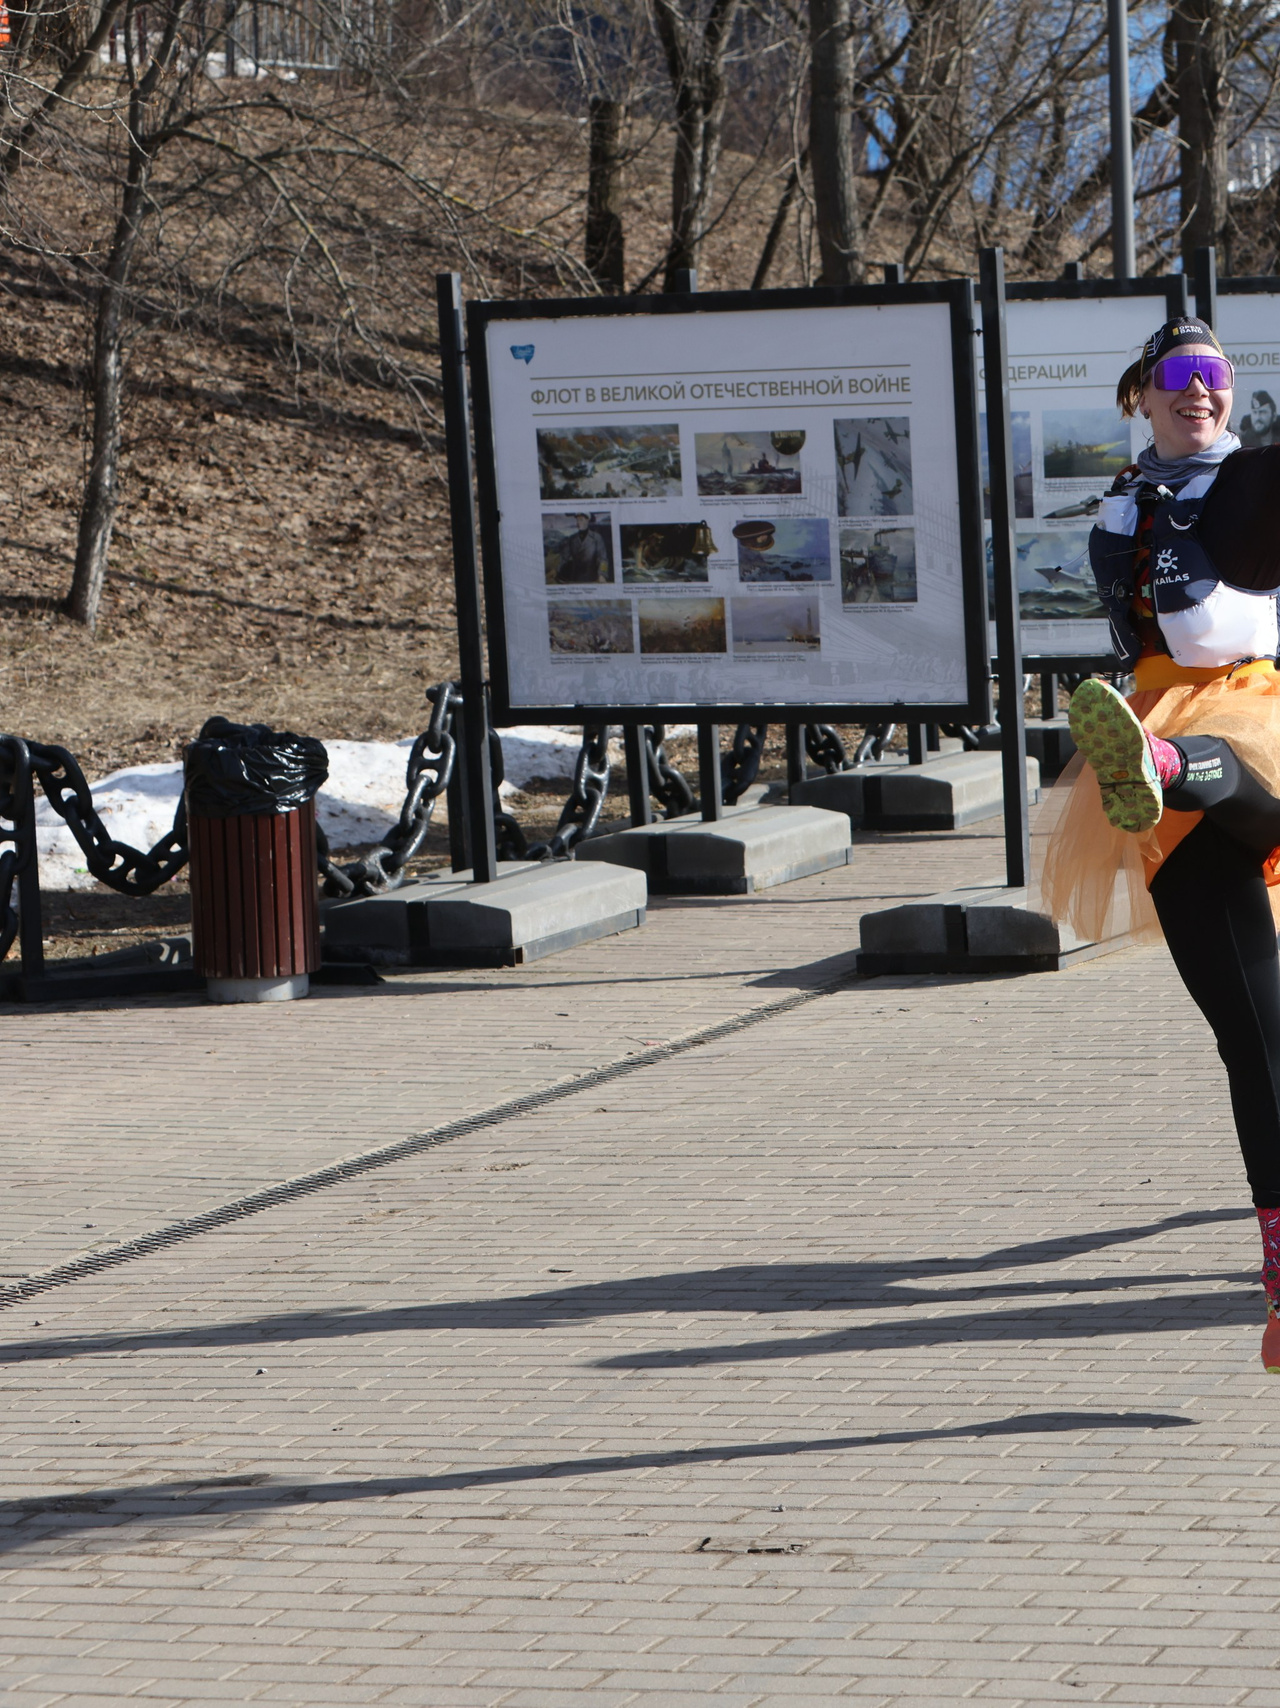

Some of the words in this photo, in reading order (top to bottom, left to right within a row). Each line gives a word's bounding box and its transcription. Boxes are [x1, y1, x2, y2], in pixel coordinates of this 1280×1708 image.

[530, 388, 581, 405] ФЛОТ
[585, 387, 597, 403] В
[600, 380, 686, 403] ВЕЛИКОЙ
[689, 375, 844, 400] ОТЕЧЕСТВЕННОЙ
[848, 373, 911, 395] ВОЙНЕ
[1155, 573, 1190, 586] KAILAS
